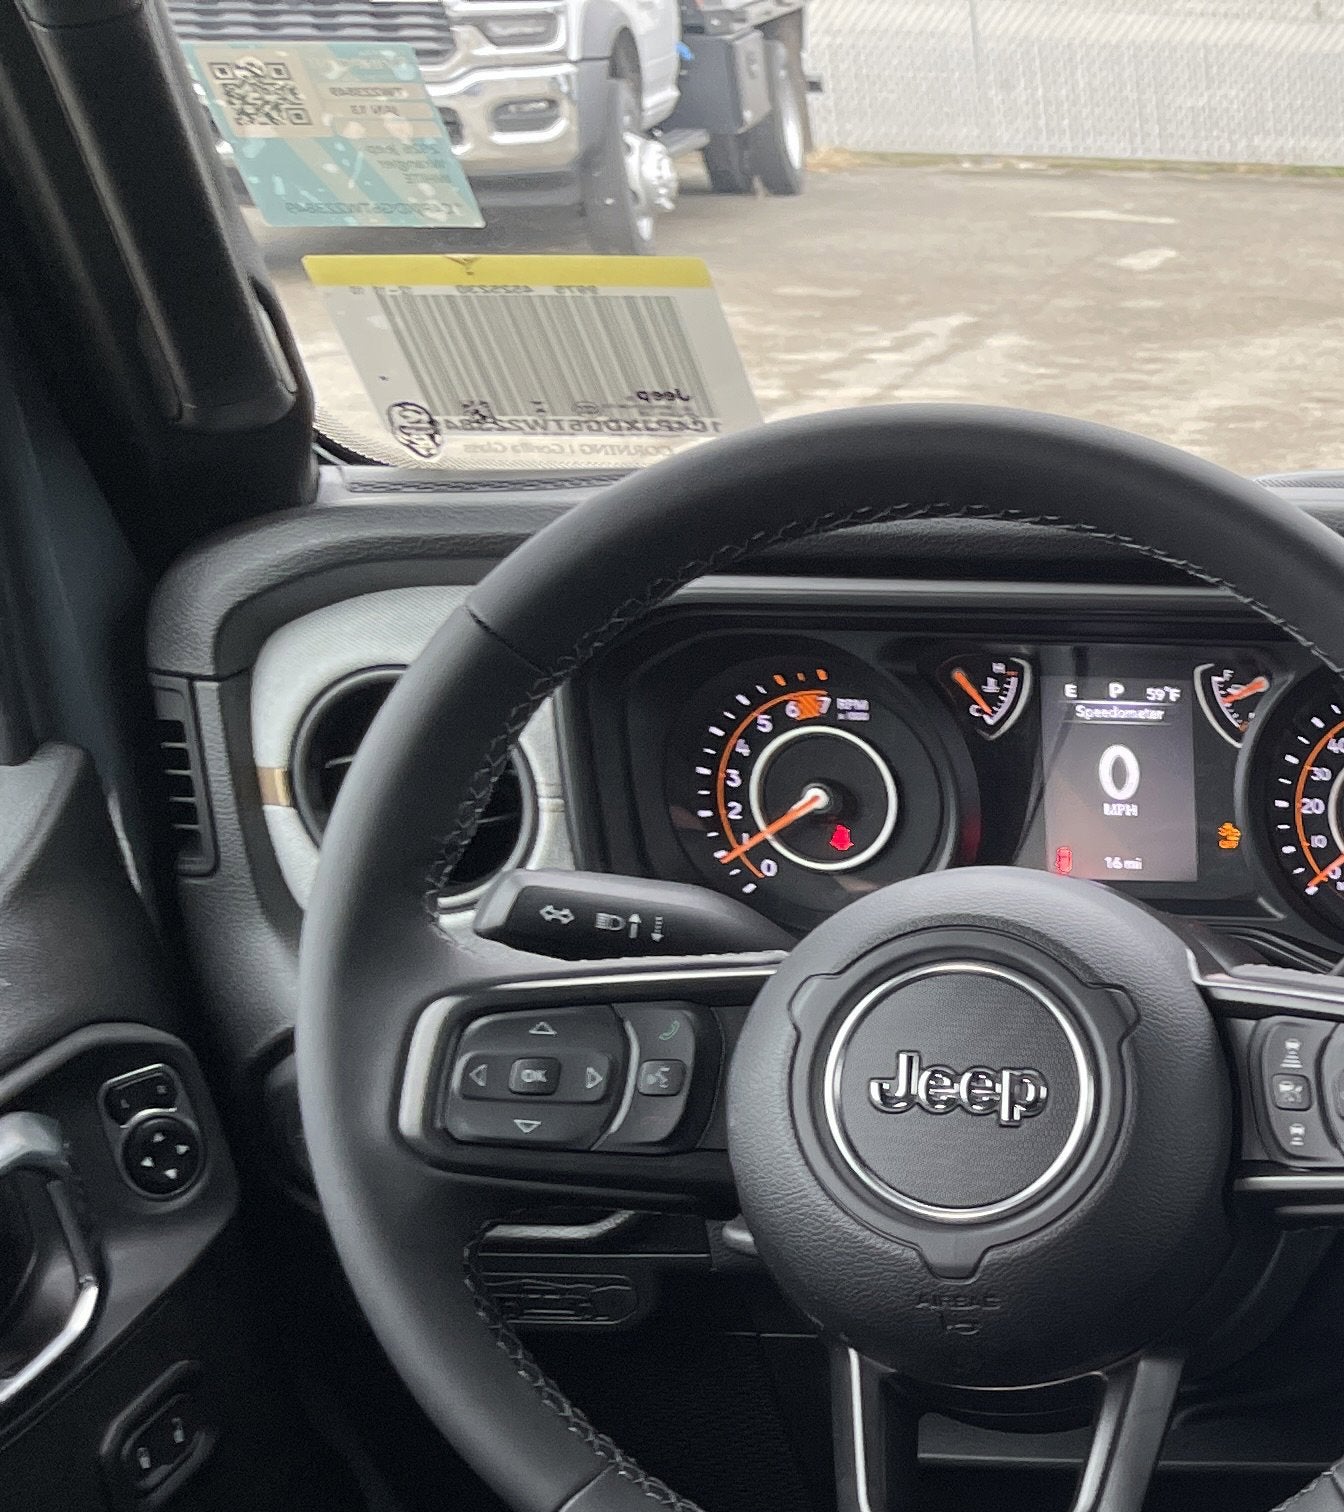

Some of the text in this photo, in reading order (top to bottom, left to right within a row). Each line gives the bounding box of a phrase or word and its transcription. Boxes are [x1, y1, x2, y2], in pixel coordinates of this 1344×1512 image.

[1109, 682, 1125, 698] P
[785, 701, 800, 718] 6
[1075, 703, 1166, 721] Speedometer
[757, 714, 773, 733] 5
[726, 769, 743, 788] 3
[1098, 743, 1141, 801] 0
[727, 801, 743, 820] 2
[1102, 803, 1139, 817] MPH
[1301, 797, 1326, 815] 20
[760, 858, 778, 877] 0
[520, 1067, 548, 1083] OK
[868, 1050, 1049, 1128] Jeep
